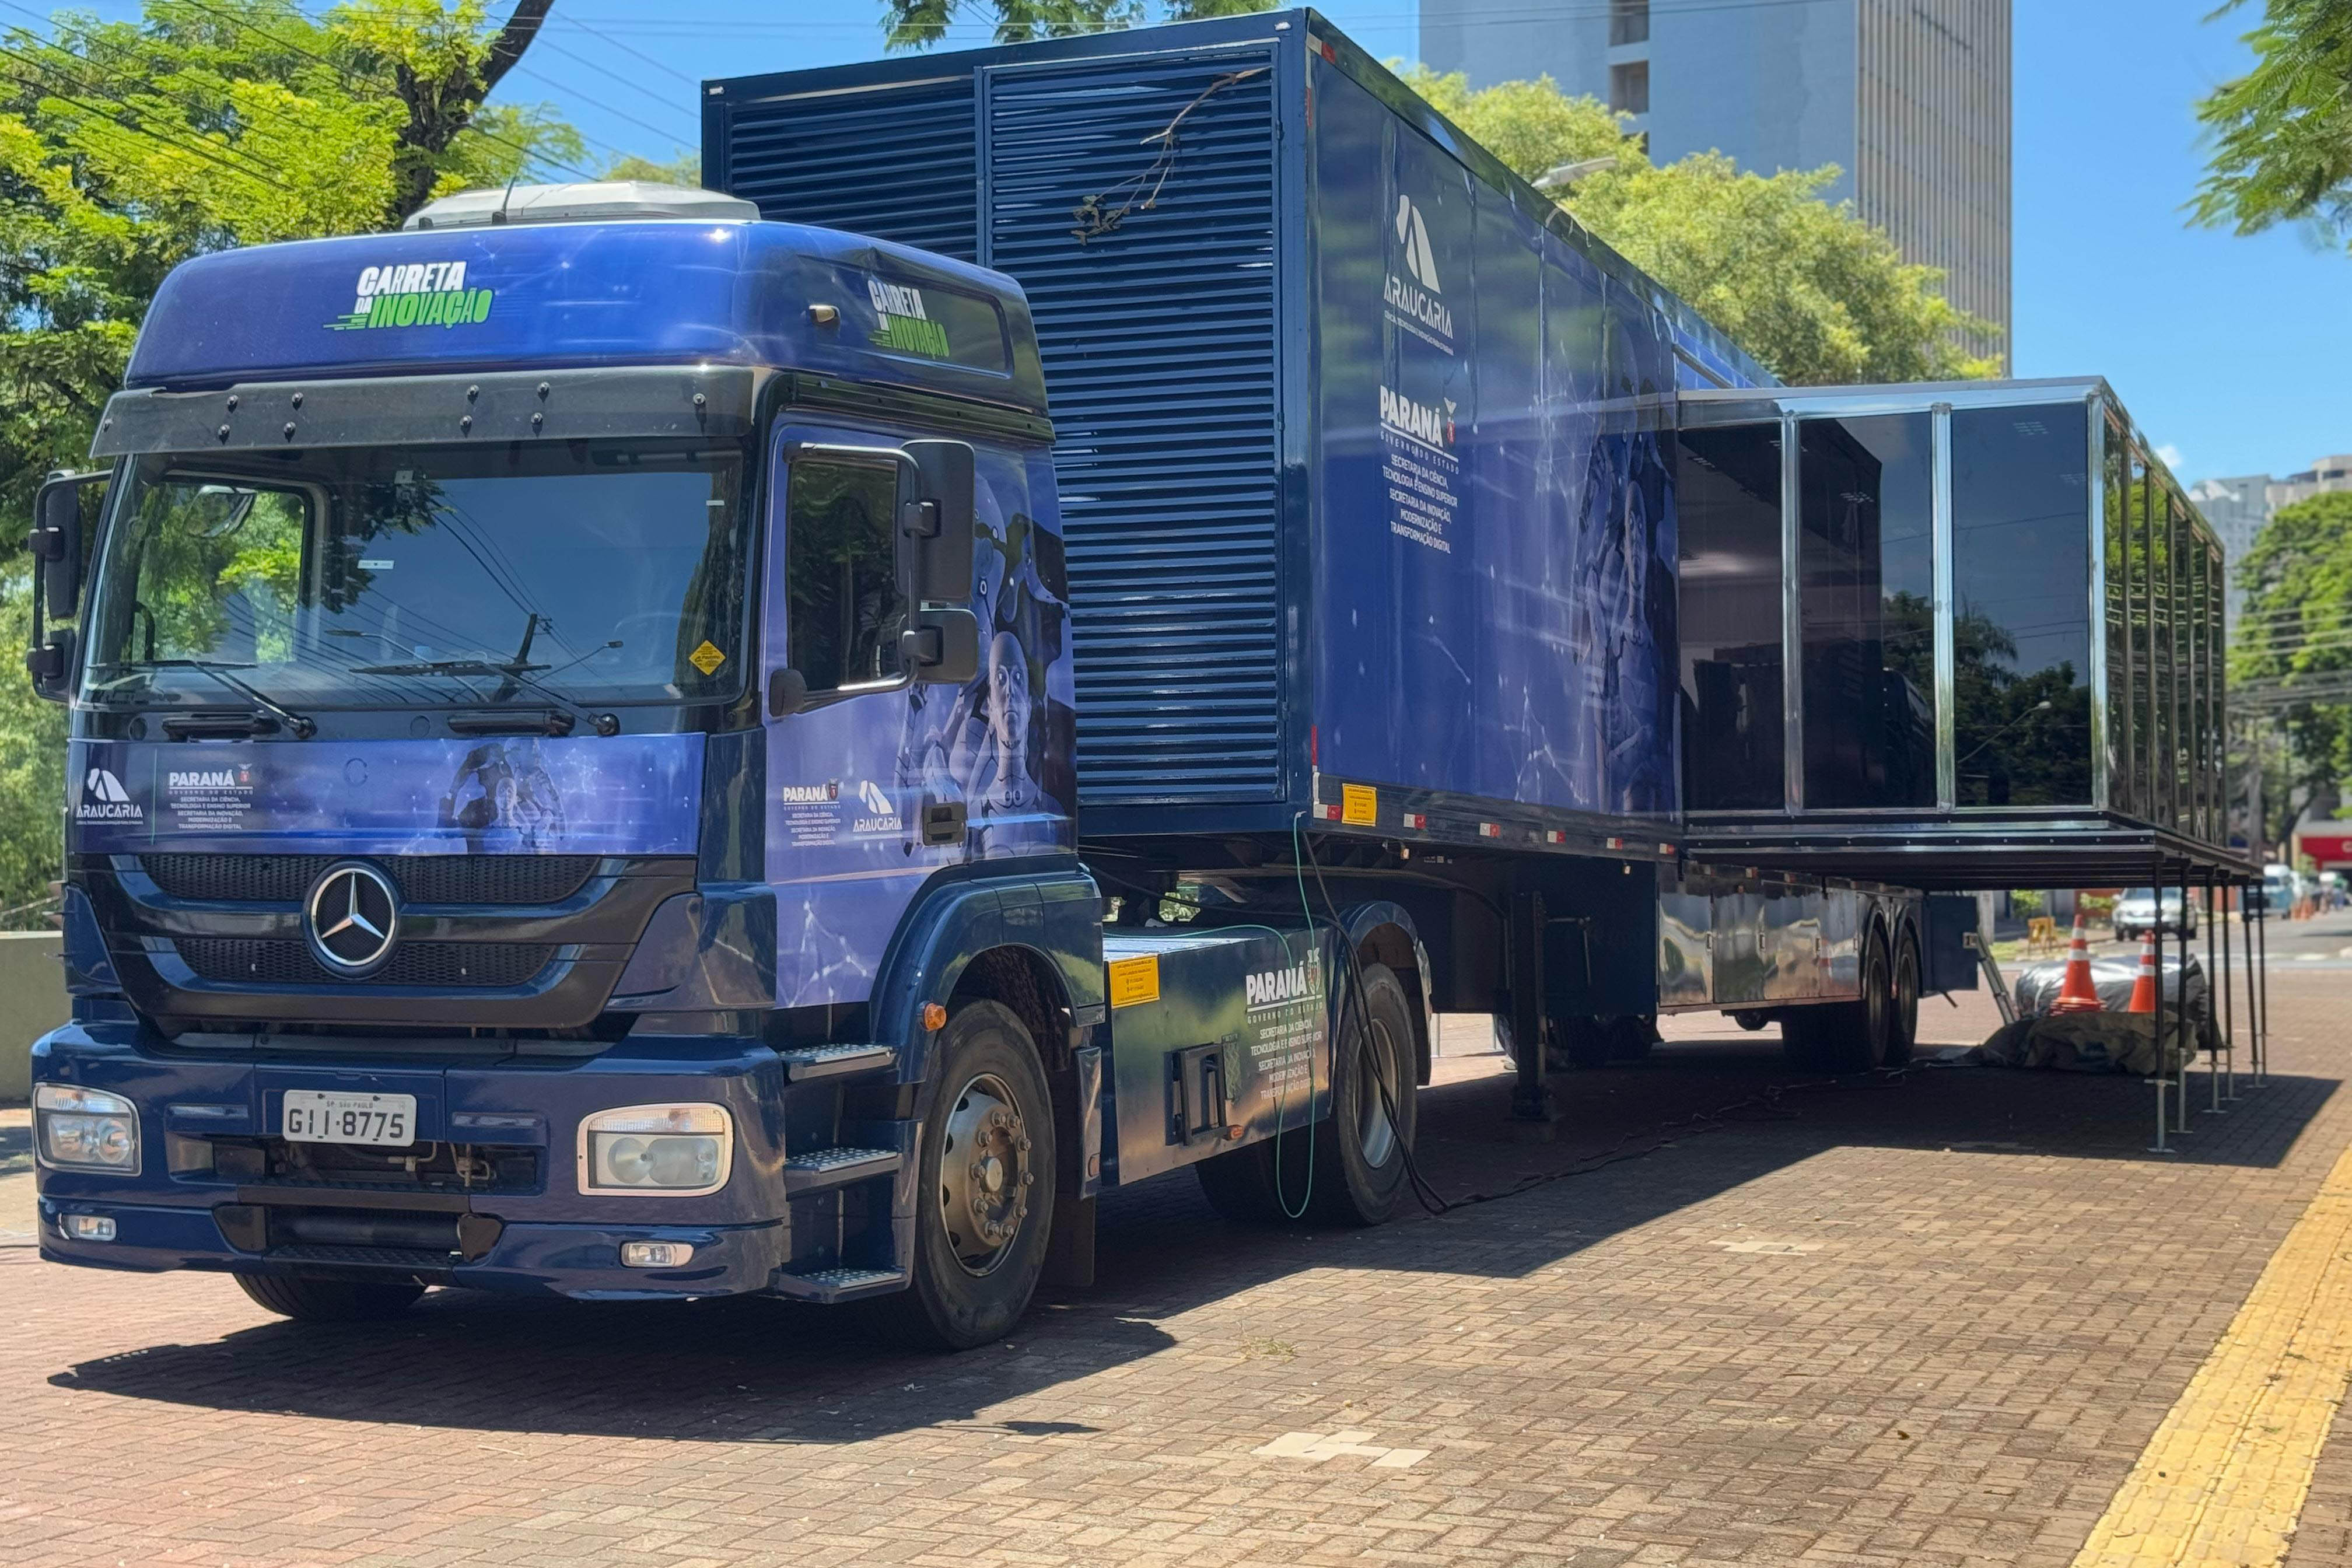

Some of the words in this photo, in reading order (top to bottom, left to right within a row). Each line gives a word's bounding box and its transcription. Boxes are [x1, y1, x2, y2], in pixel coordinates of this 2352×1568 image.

[356, 261, 467, 296] CARRETA
[354, 296, 372, 315] DA
[369, 288, 494, 329] INOVAÇÃO
[868, 280, 927, 320] CARRETA
[1384, 272, 1453, 340] ARAUCARIA
[887, 314, 950, 359] INOVAÇÃO
[1380, 384, 1443, 448] PARANÁ
[1380, 430, 1417, 456] GOVERNO
[1420, 449, 1429, 461] DO
[1433, 455, 1459, 475] ESTADO
[169, 769, 235, 786] PARANÁ
[784, 783, 828, 802] PARANÁ
[76, 804, 144, 818] ARAUCARIA
[853, 817, 903, 832] ARAUCARIA
[1246, 960, 1307, 1005] PARANÁ
